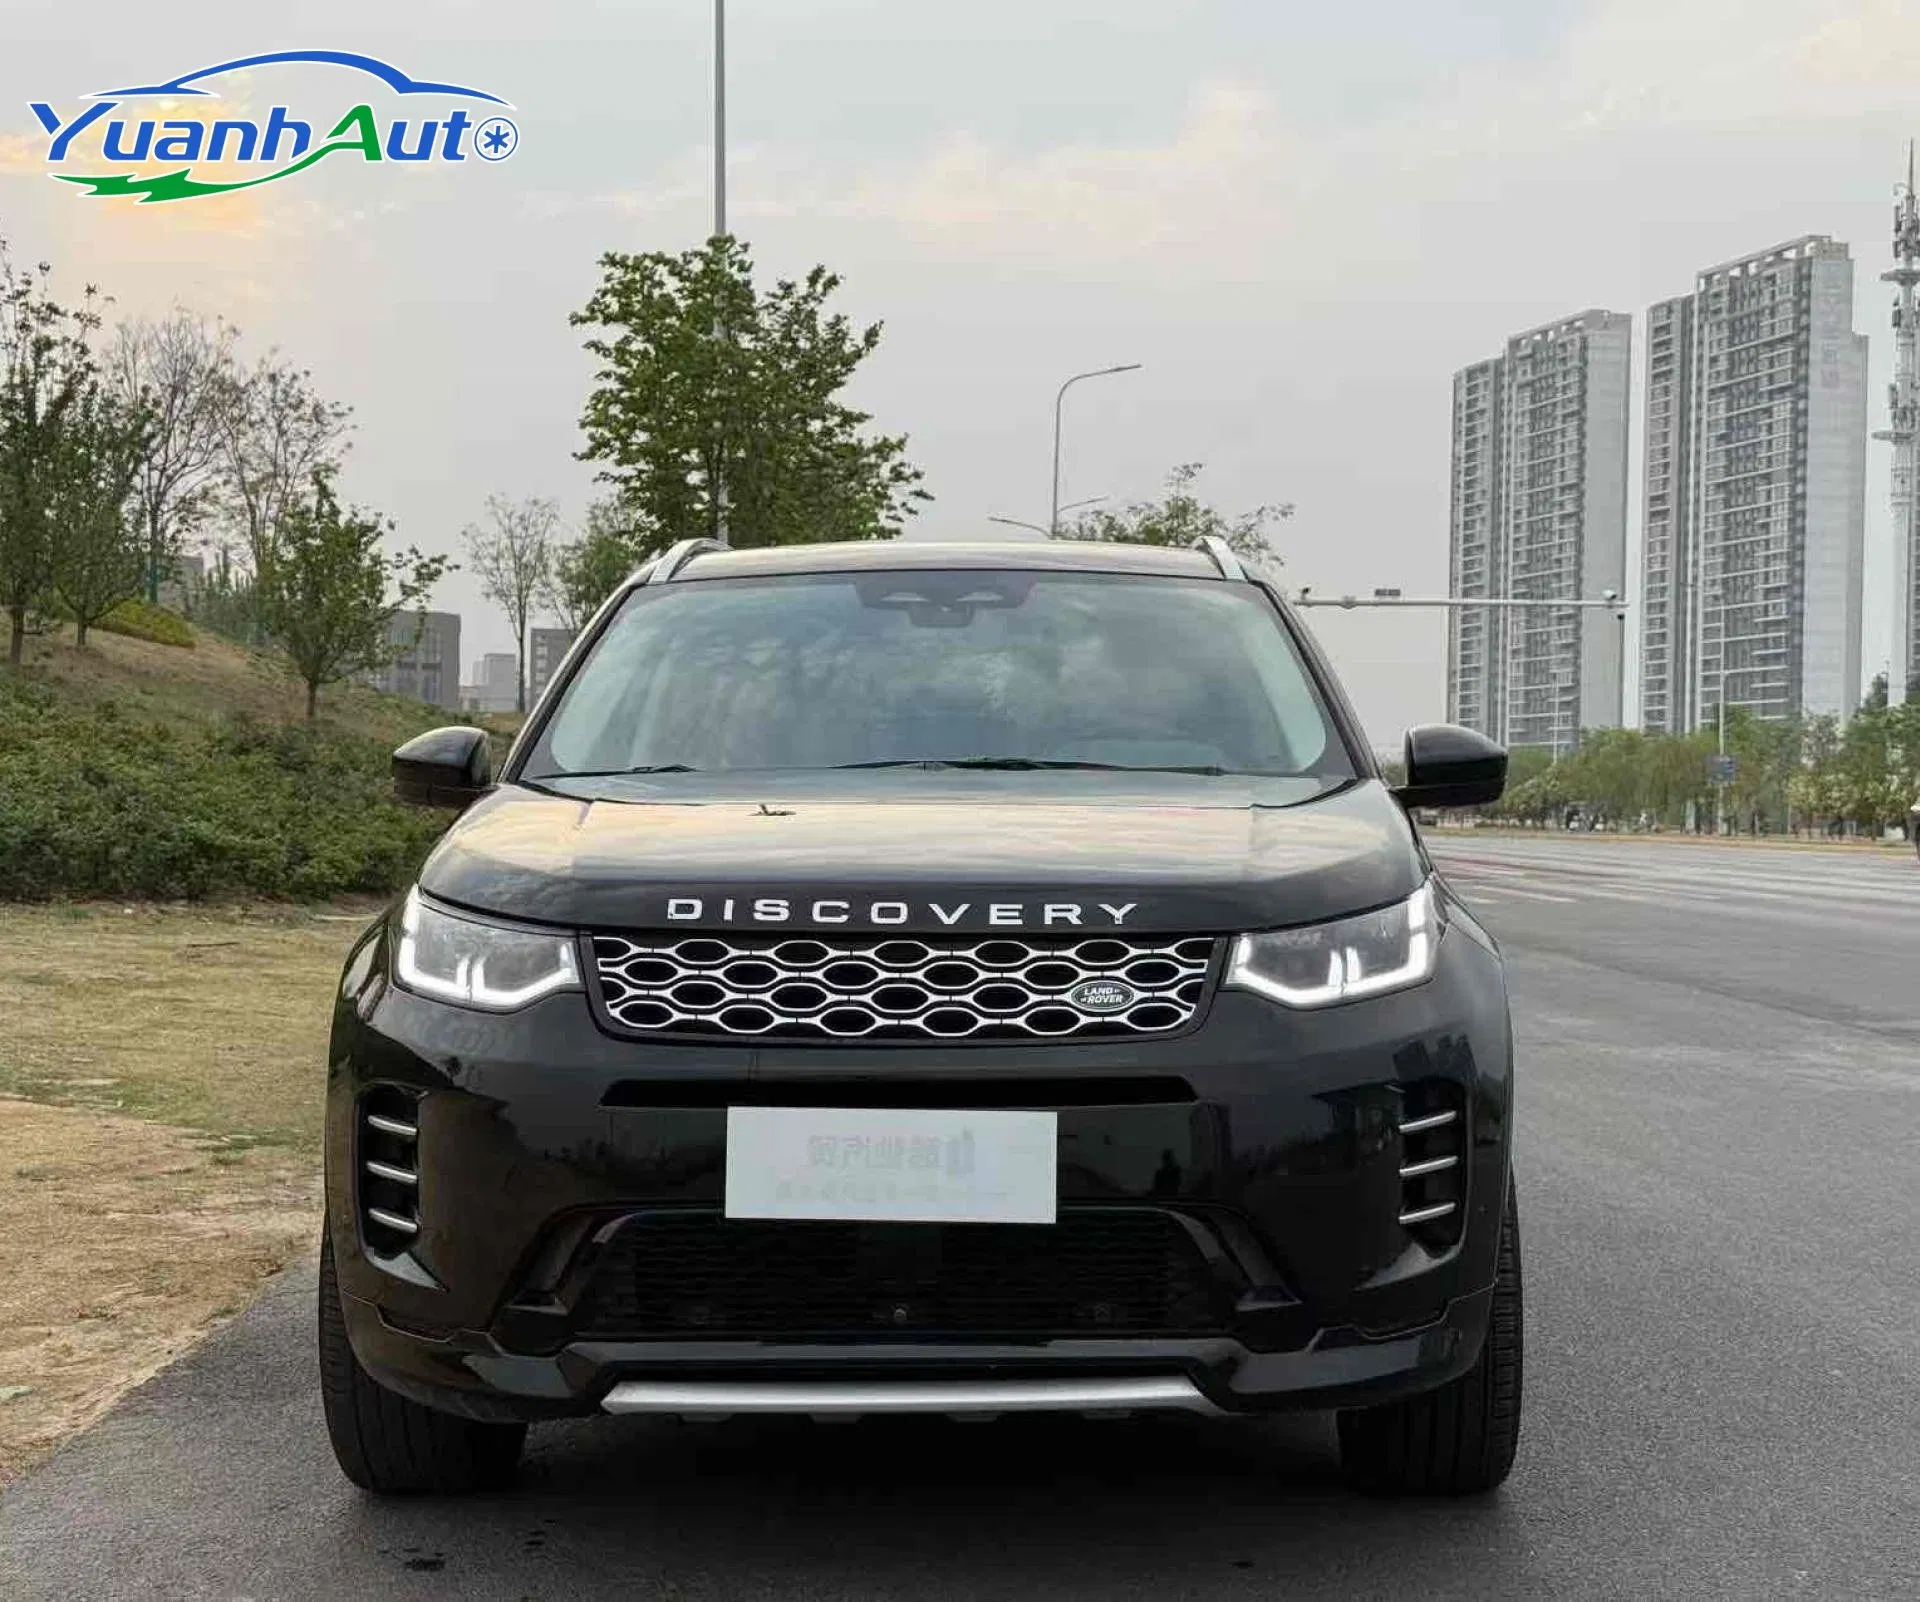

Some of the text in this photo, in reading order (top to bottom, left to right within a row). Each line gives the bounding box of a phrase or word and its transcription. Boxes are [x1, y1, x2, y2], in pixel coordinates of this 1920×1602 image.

[666, 898, 1138, 925] DISCOVERY
[1084, 986, 1114, 995] LAND
[1086, 995, 1124, 1004] ROVER
